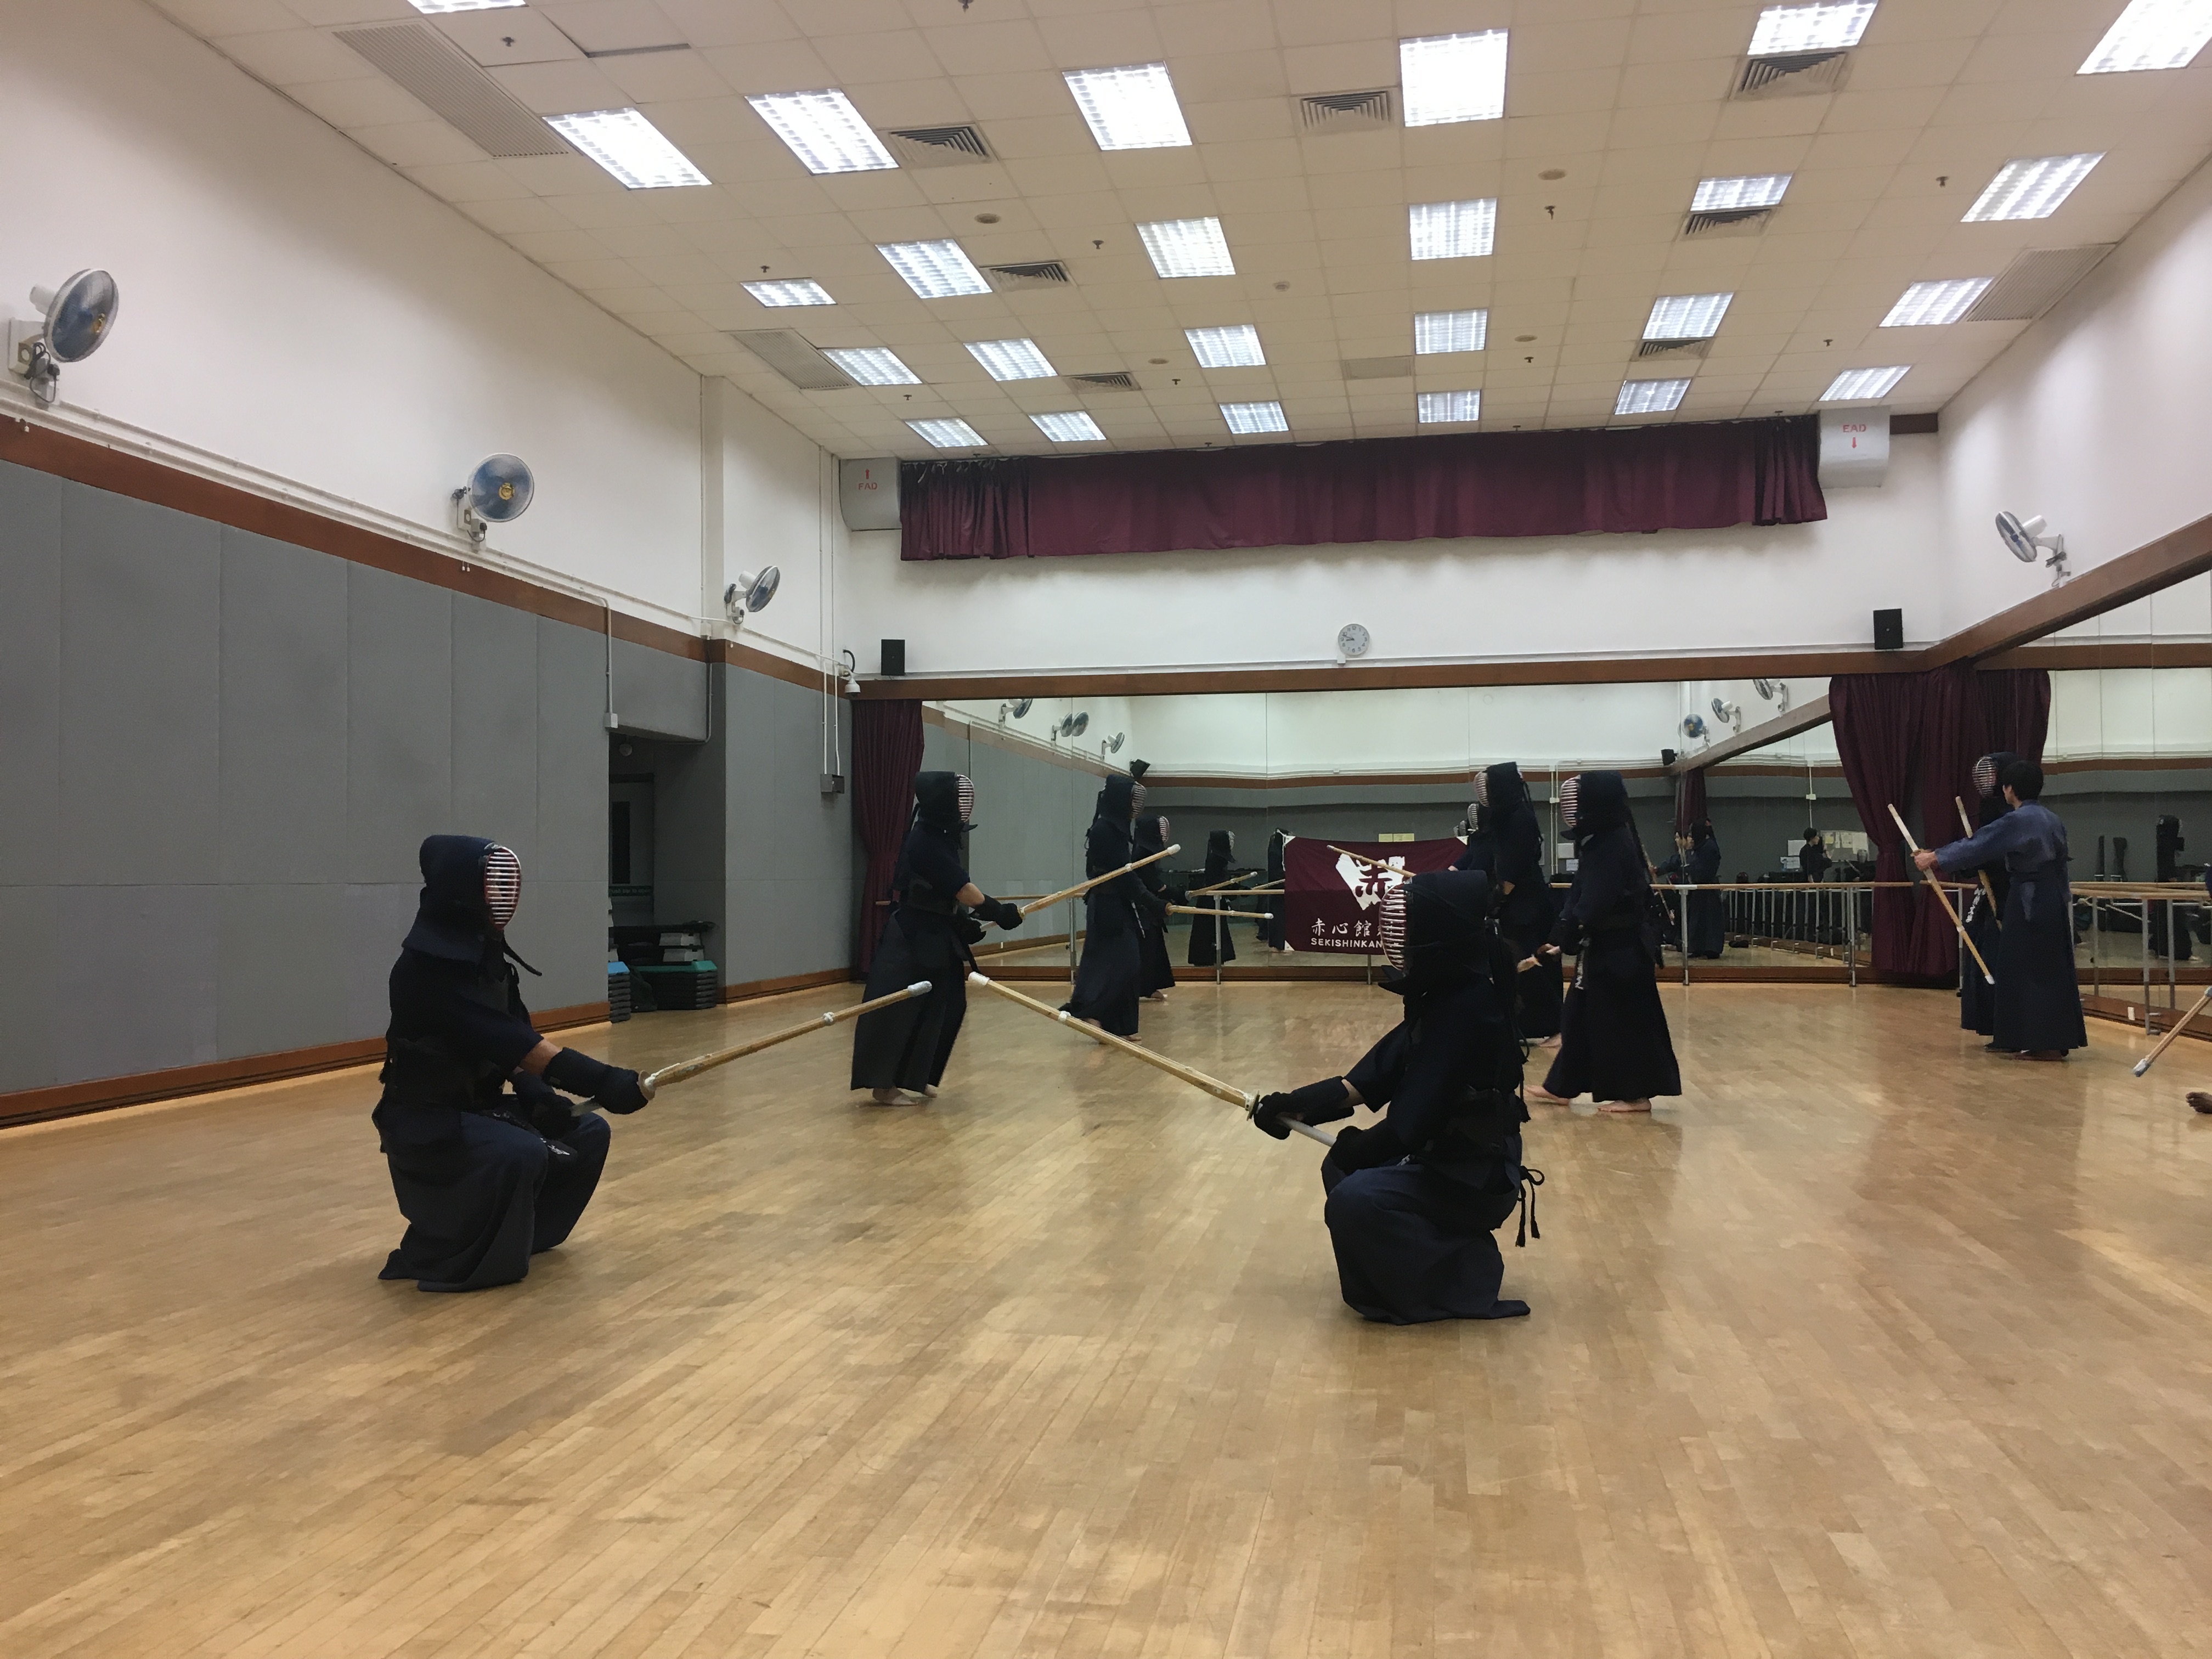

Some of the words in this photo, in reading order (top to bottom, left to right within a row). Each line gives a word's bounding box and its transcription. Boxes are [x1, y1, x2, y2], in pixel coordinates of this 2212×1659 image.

[1842, 424, 1867, 433] EAD
[858, 482, 878, 490] FAD
[1311, 917, 1382, 937] 赤心館
[1311, 938, 1383, 949] SEKISHINKAN
